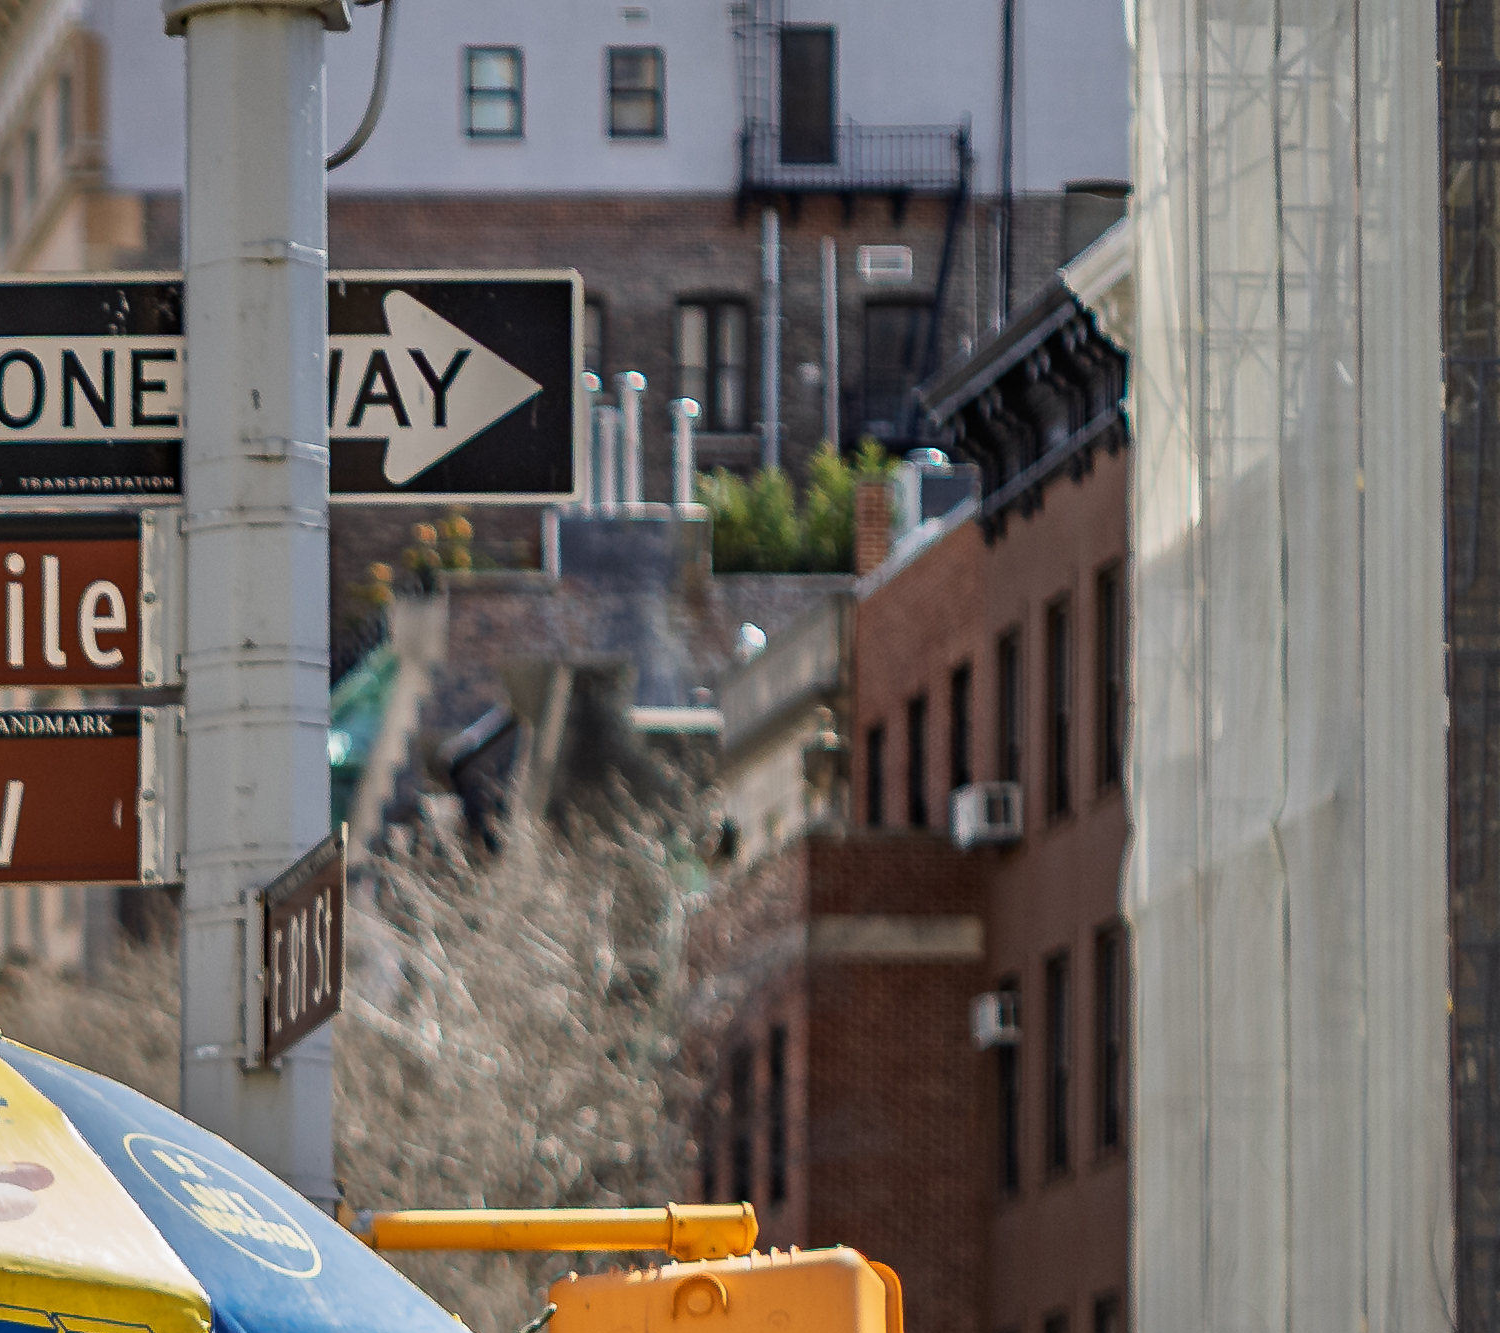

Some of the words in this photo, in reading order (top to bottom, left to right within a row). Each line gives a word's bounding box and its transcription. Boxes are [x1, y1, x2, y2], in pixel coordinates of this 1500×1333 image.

[328, 349, 473, 428] AY
[19, 476, 177, 491] TRANSPORTATION
[270, 928, 283, 1034] E
[288, 906, 308, 1024] 81
[312, 886, 332, 1005] St
